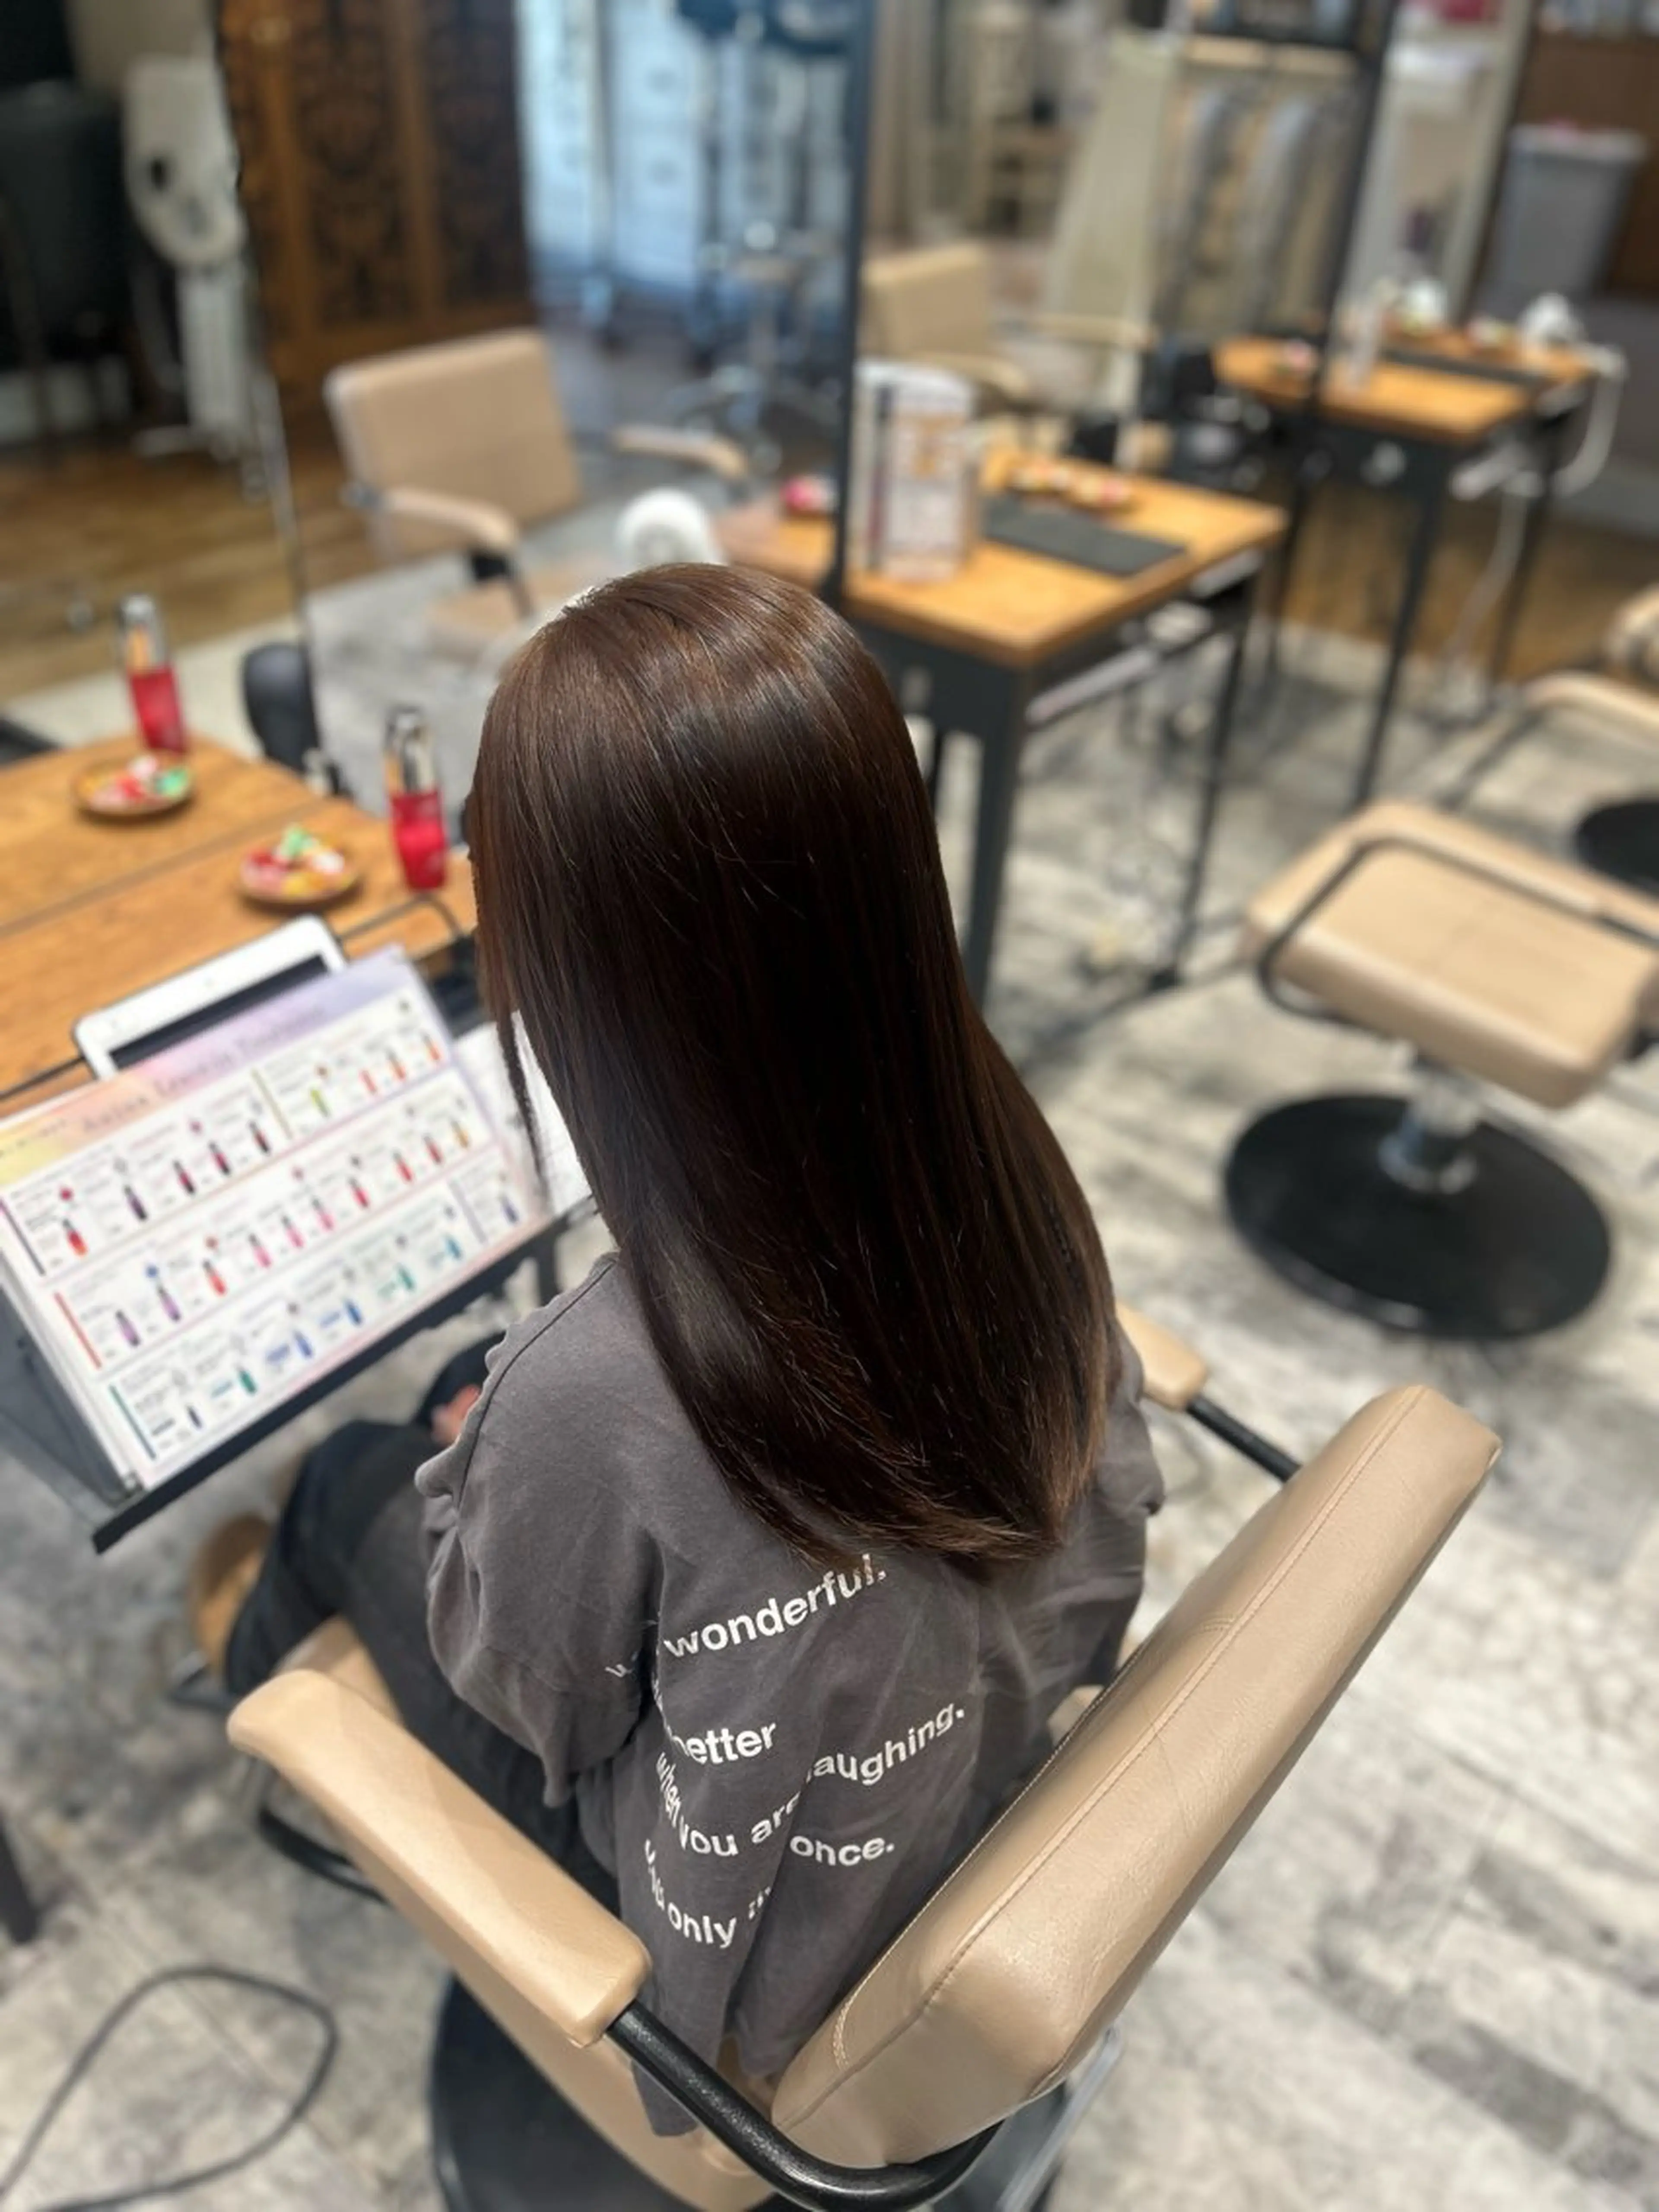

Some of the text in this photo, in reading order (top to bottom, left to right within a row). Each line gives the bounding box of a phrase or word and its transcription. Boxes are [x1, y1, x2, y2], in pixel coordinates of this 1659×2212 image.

[663, 1554, 887, 1657] wonderful.
[667, 1902, 737, 1949] only
[790, 1835, 895, 1866] once.
